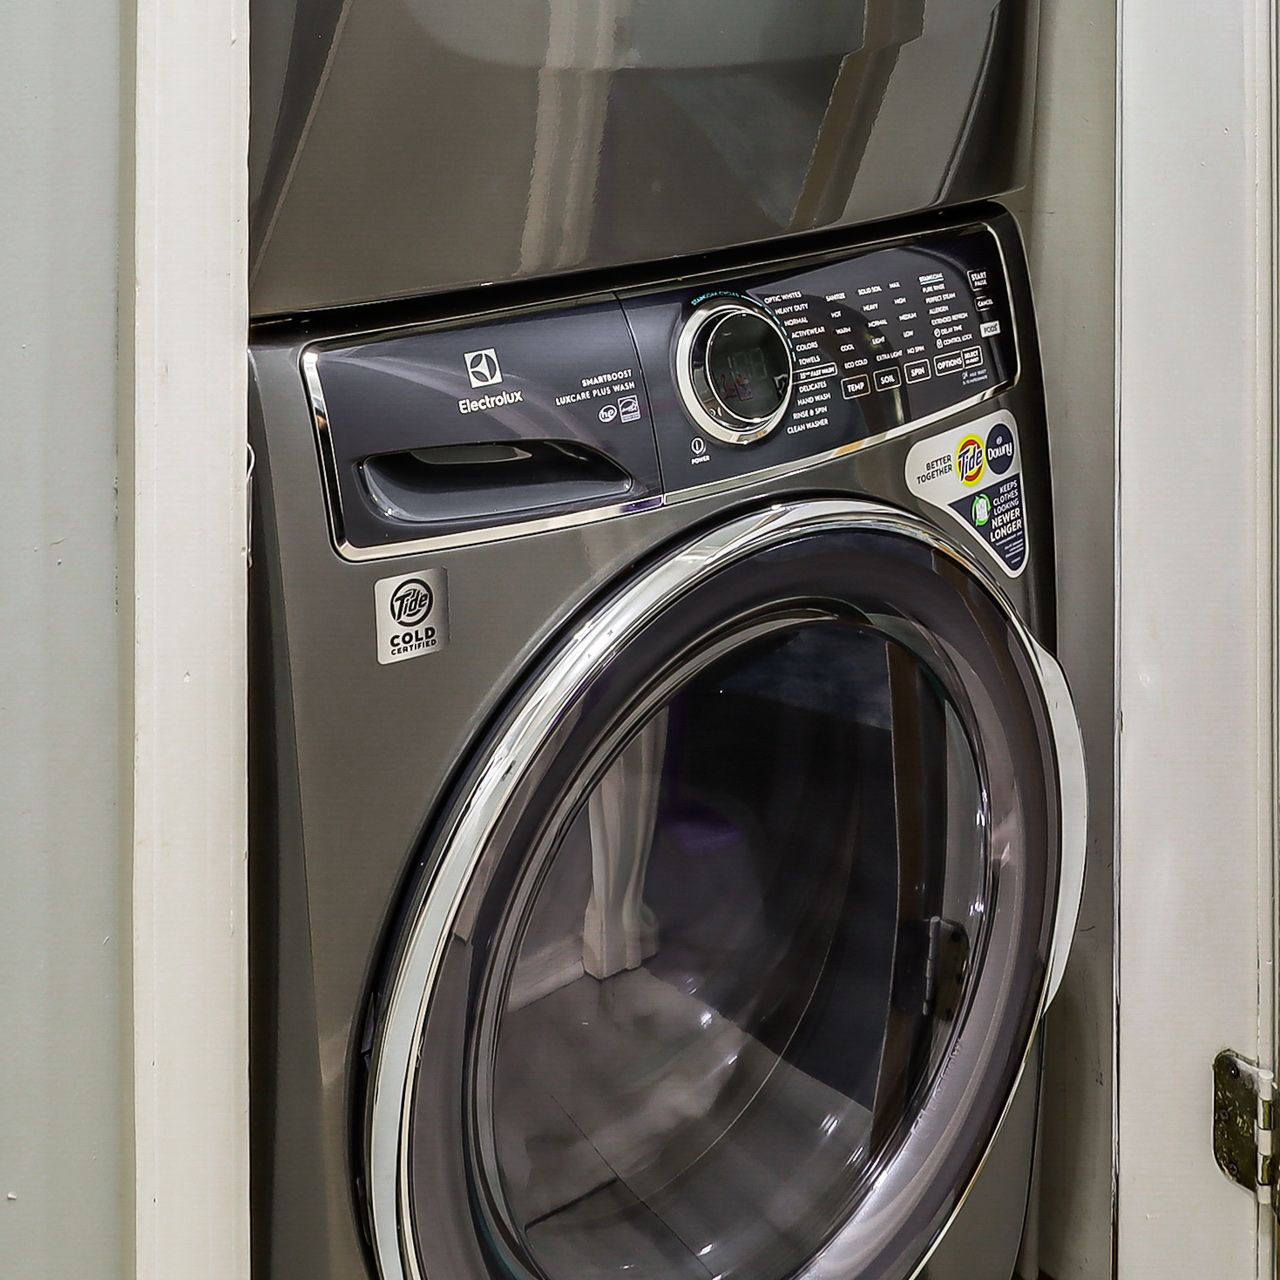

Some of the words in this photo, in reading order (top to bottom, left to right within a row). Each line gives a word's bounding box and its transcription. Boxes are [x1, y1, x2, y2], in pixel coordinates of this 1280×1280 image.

[971, 272, 987, 281] START
[764, 294, 781, 304] OPTIC
[781, 291, 802, 301] WHITES
[775, 307, 792, 315] HEAVY
[793, 303, 809, 312] DUTY
[784, 317, 808, 327] NORMAL
[791, 326, 825, 339] ACTIVEWEAR
[796, 341, 818, 352] COLORS
[840, 344, 854, 352] COOL
[799, 355, 821, 365] TOWELS
[844, 361, 855, 369] ECO
[855, 359, 868, 367] COLD
[937, 358, 962, 369] OPTIONS
[582, 369, 632, 388] SMARTBOOST
[911, 367, 925, 377] SPIN
[880, 375, 895, 384] SOIL
[799, 381, 827, 393] DELICATES
[847, 383, 865, 393] TEMP
[556, 390, 591, 406] LUXCARE
[592, 387, 611, 398] PLUS
[613, 382, 635, 394] WASH
[797, 396, 814, 406] HAND
[814, 393, 831, 402] WASH
[458, 390, 524, 414] Electrolux
[793, 410, 808, 420] RINSE
[814, 406, 828, 415] SPIN
[787, 423, 805, 434] CLEAN
[805, 418, 829, 431] WASHER
[988, 442, 1012, 460] Downy
[926, 455, 952, 471] BETTER
[958, 444, 983, 482] Tide
[916, 464, 953, 485] TOGETHER
[999, 480, 1017, 493] KEEPS
[993, 489, 1018, 506] CLOTHES
[993, 499, 1019, 515] LOOKING
[992, 508, 1020, 529] NEWER
[990, 521, 1022, 542] LONGER
[394, 589, 428, 621] Tide
[390, 626, 436, 647] COLD
[391, 639, 436, 655] CERTIFIED
